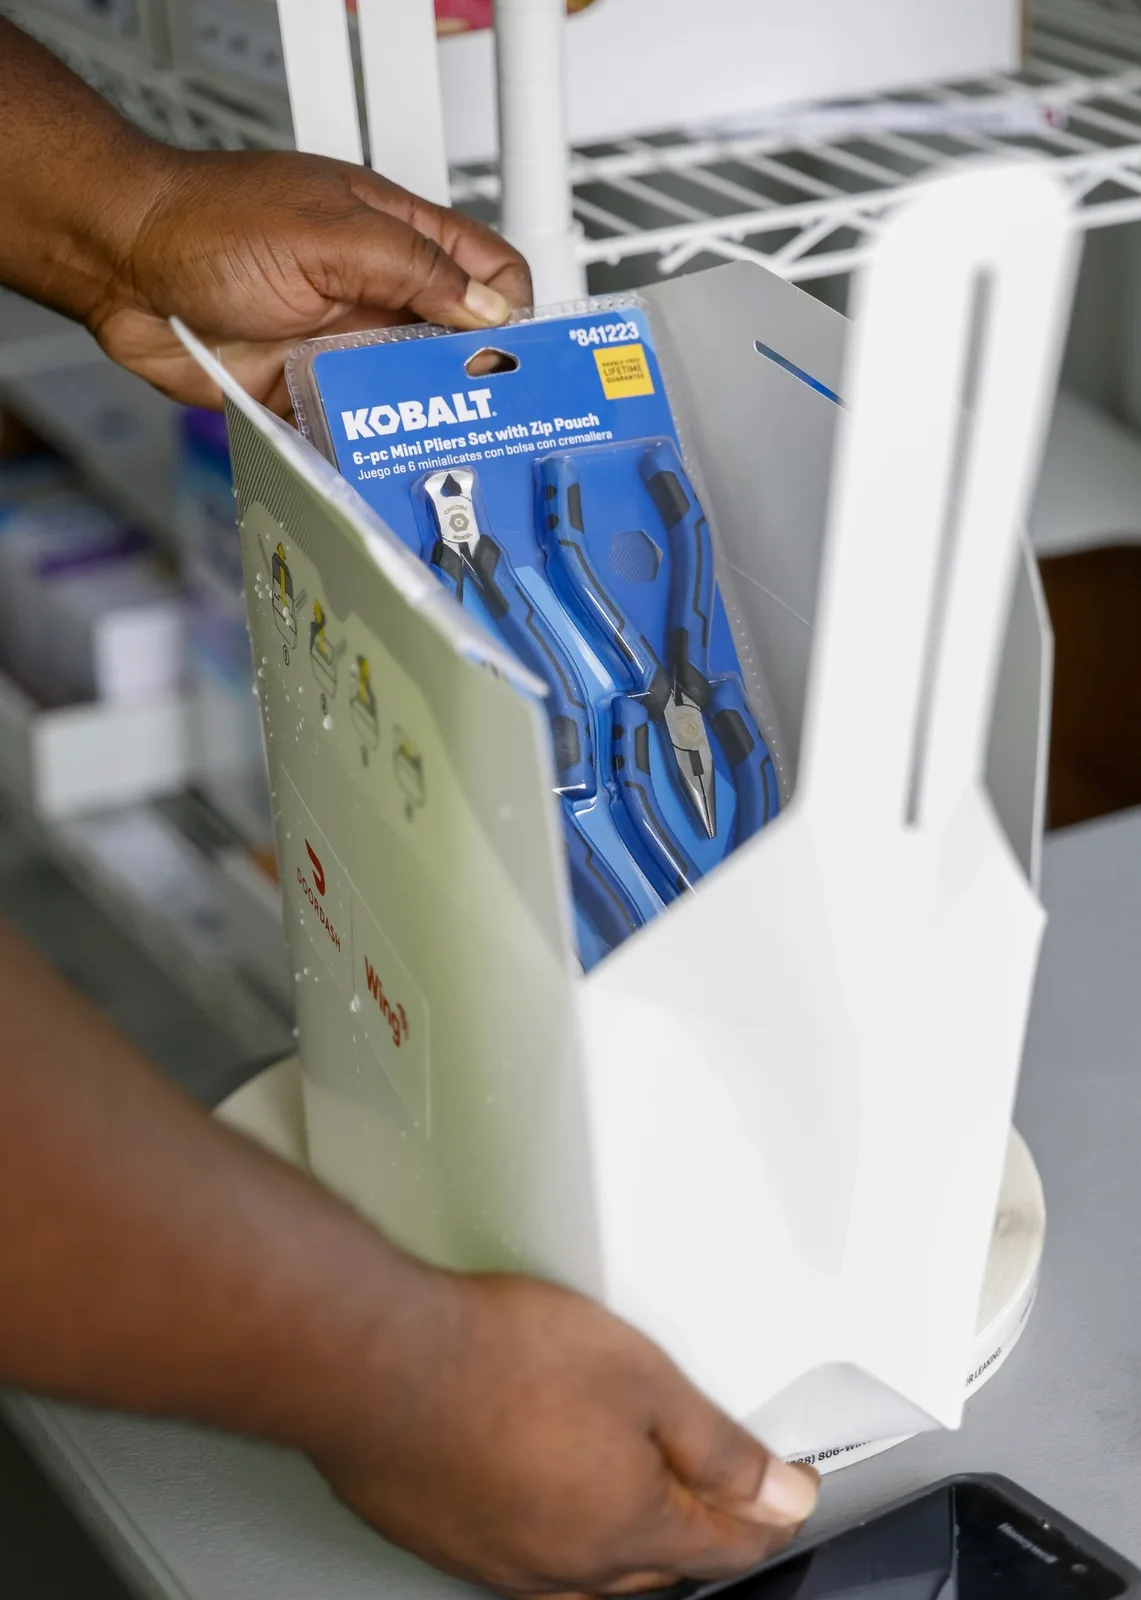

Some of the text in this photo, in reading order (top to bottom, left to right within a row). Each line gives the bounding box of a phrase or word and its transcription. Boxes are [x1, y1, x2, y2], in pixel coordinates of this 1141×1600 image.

[569, 322, 640, 346] #841223
[341, 388, 492, 441] KOBALT
[353, 412, 600, 466] 6-pc Mini Pliers Set with Zip Pouch
[357, 430, 613, 480] Juego de 6 minialicates con bolsa con cremallera
[297, 867, 341, 953] DOORDASH
[364, 955, 401, 1048] Wing
